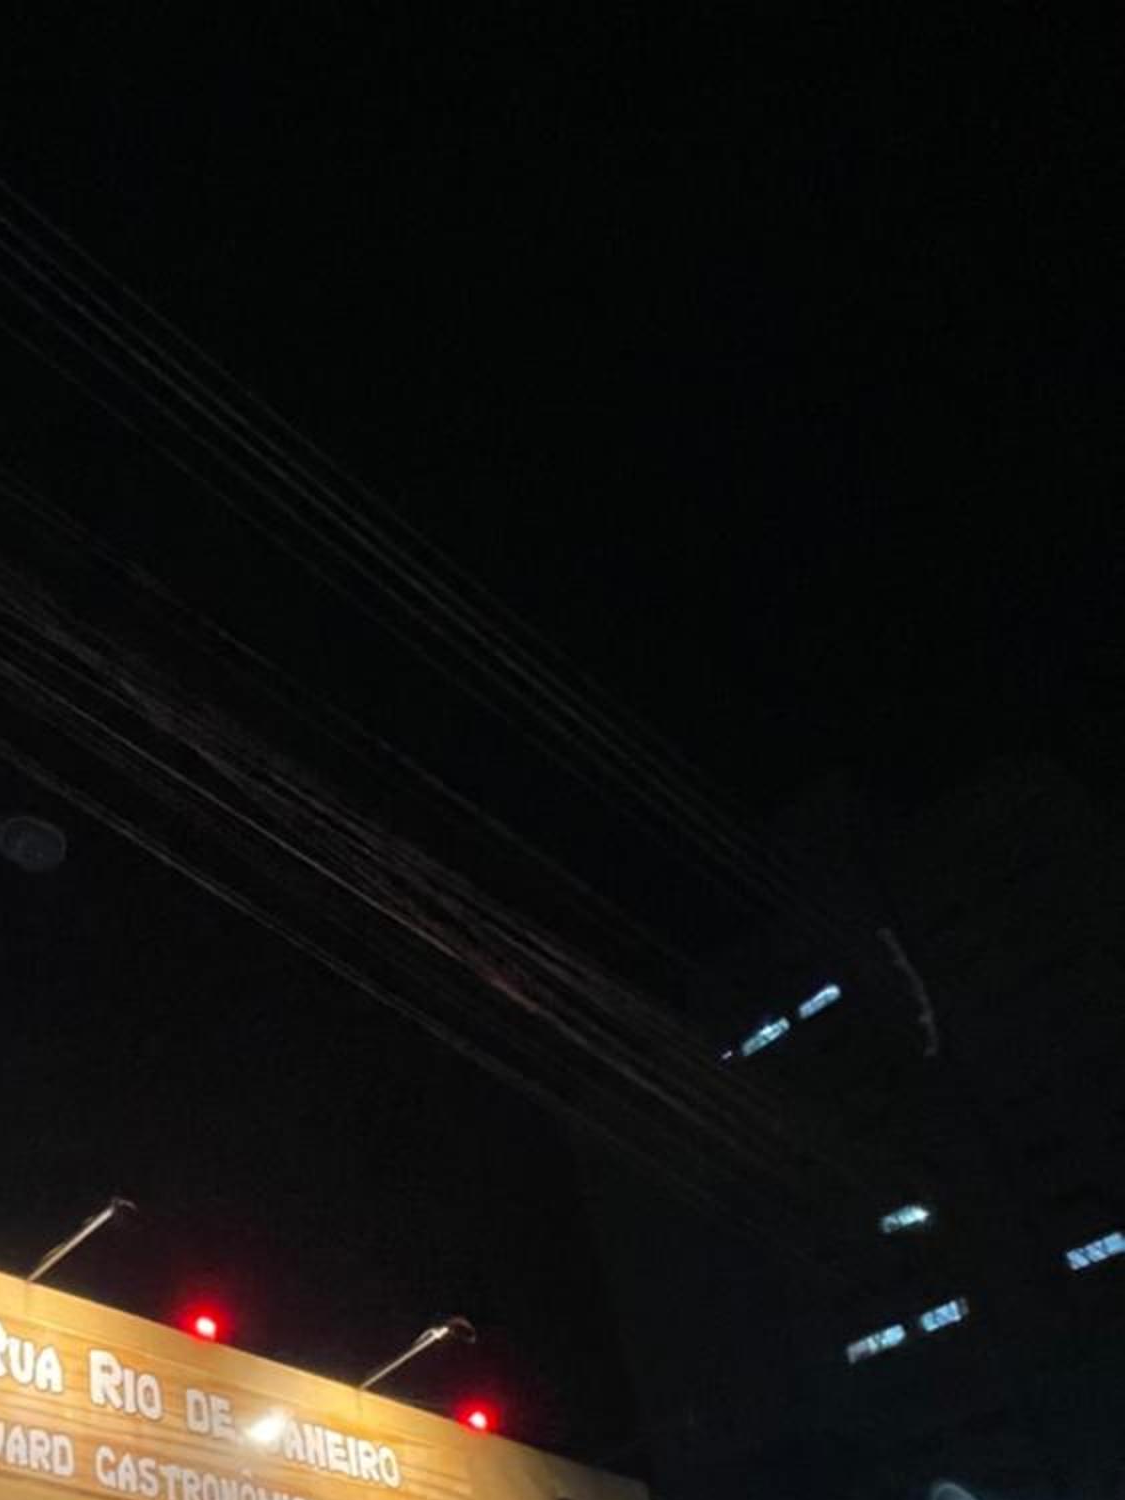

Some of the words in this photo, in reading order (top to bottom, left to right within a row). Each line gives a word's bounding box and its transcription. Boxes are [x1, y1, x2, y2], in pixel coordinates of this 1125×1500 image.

[88, 1348, 164, 1421] RIO
[186, 1388, 237, 1441] DE
[265, 1408, 402, 1489] ANEIRO
